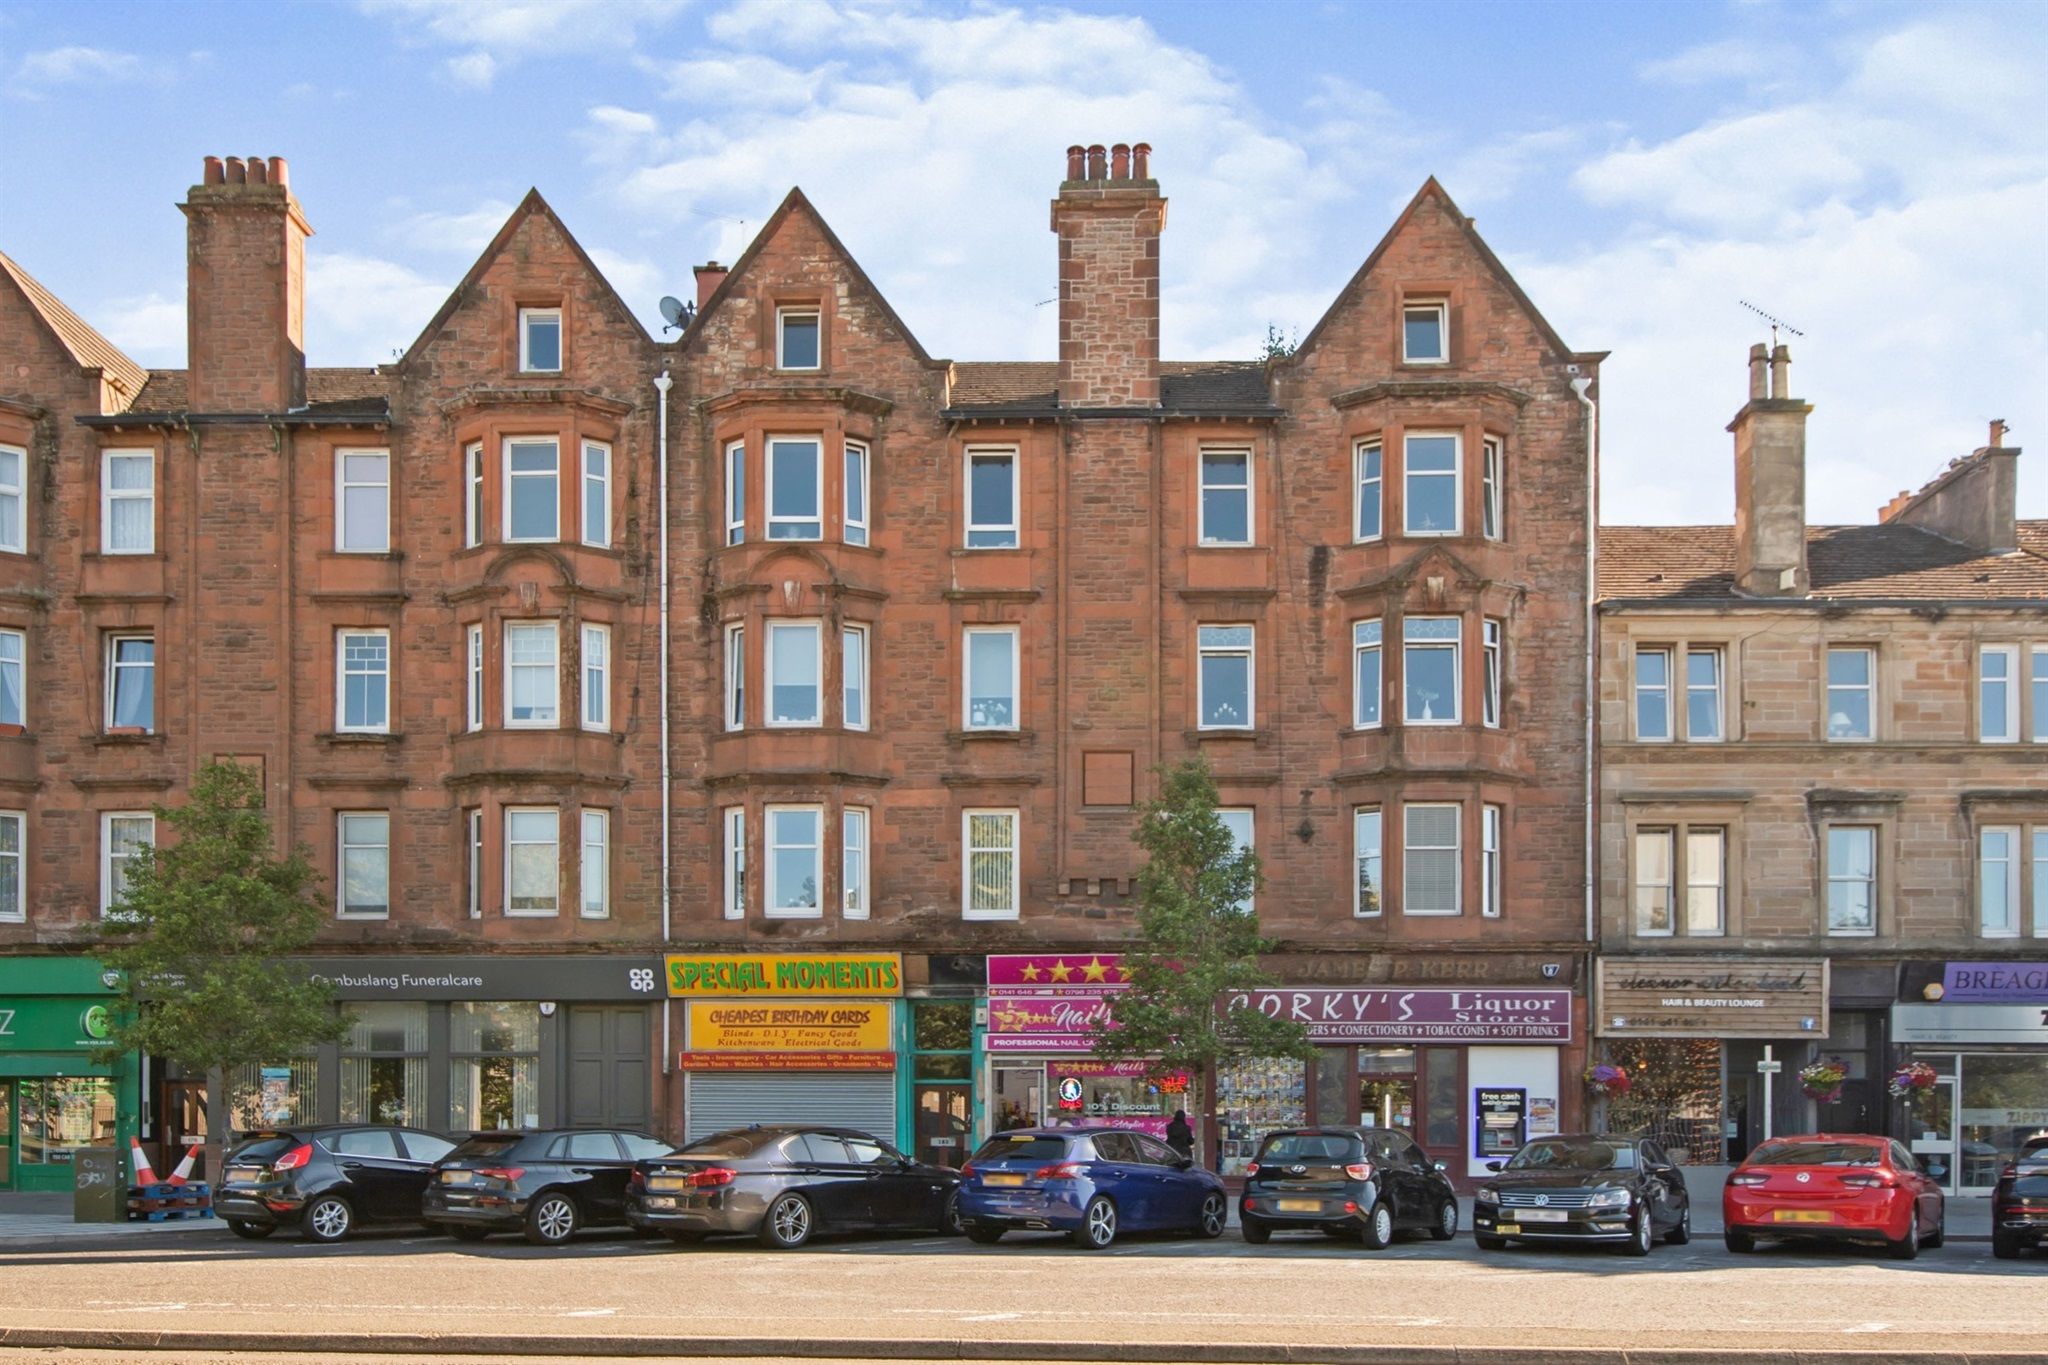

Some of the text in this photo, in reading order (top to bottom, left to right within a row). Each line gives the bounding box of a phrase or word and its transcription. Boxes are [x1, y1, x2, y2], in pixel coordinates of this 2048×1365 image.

[401, 973, 483, 986] Funeralcare
[670, 961, 899, 993] SPECIAL MOMENTS
[1450, 993, 1556, 1013] Liquor
[1662, 999, 1683, 1007] HAIR
[1693, 999, 1727, 1007] BEAUTY
[1728, 999, 1765, 1007] LOUNGE
[709, 1009, 871, 1024] CHEAPEST BIRTHDAY CARDS
[1455, 1011, 1550, 1023] Stores
[723, 1029, 754, 1038] Blinds
[798, 1029, 826, 1039] Fancy
[829, 1029, 857, 1038] Goods
[1306, 1025, 1329, 1035] DERS
[1338, 1025, 1415, 1035] CONFECTIONERY
[1425, 1025, 1490, 1036] TOBACCONIST
[1501, 1025, 1525, 1036] SOFT
[1526, 1025, 1559, 1036] DRINKS
[717, 1038, 862, 1047] Kitchenware Electrical Goods
[1481, 1092, 1521, 1100] free cash
[1111, 1102, 1161, 1111] Discount
